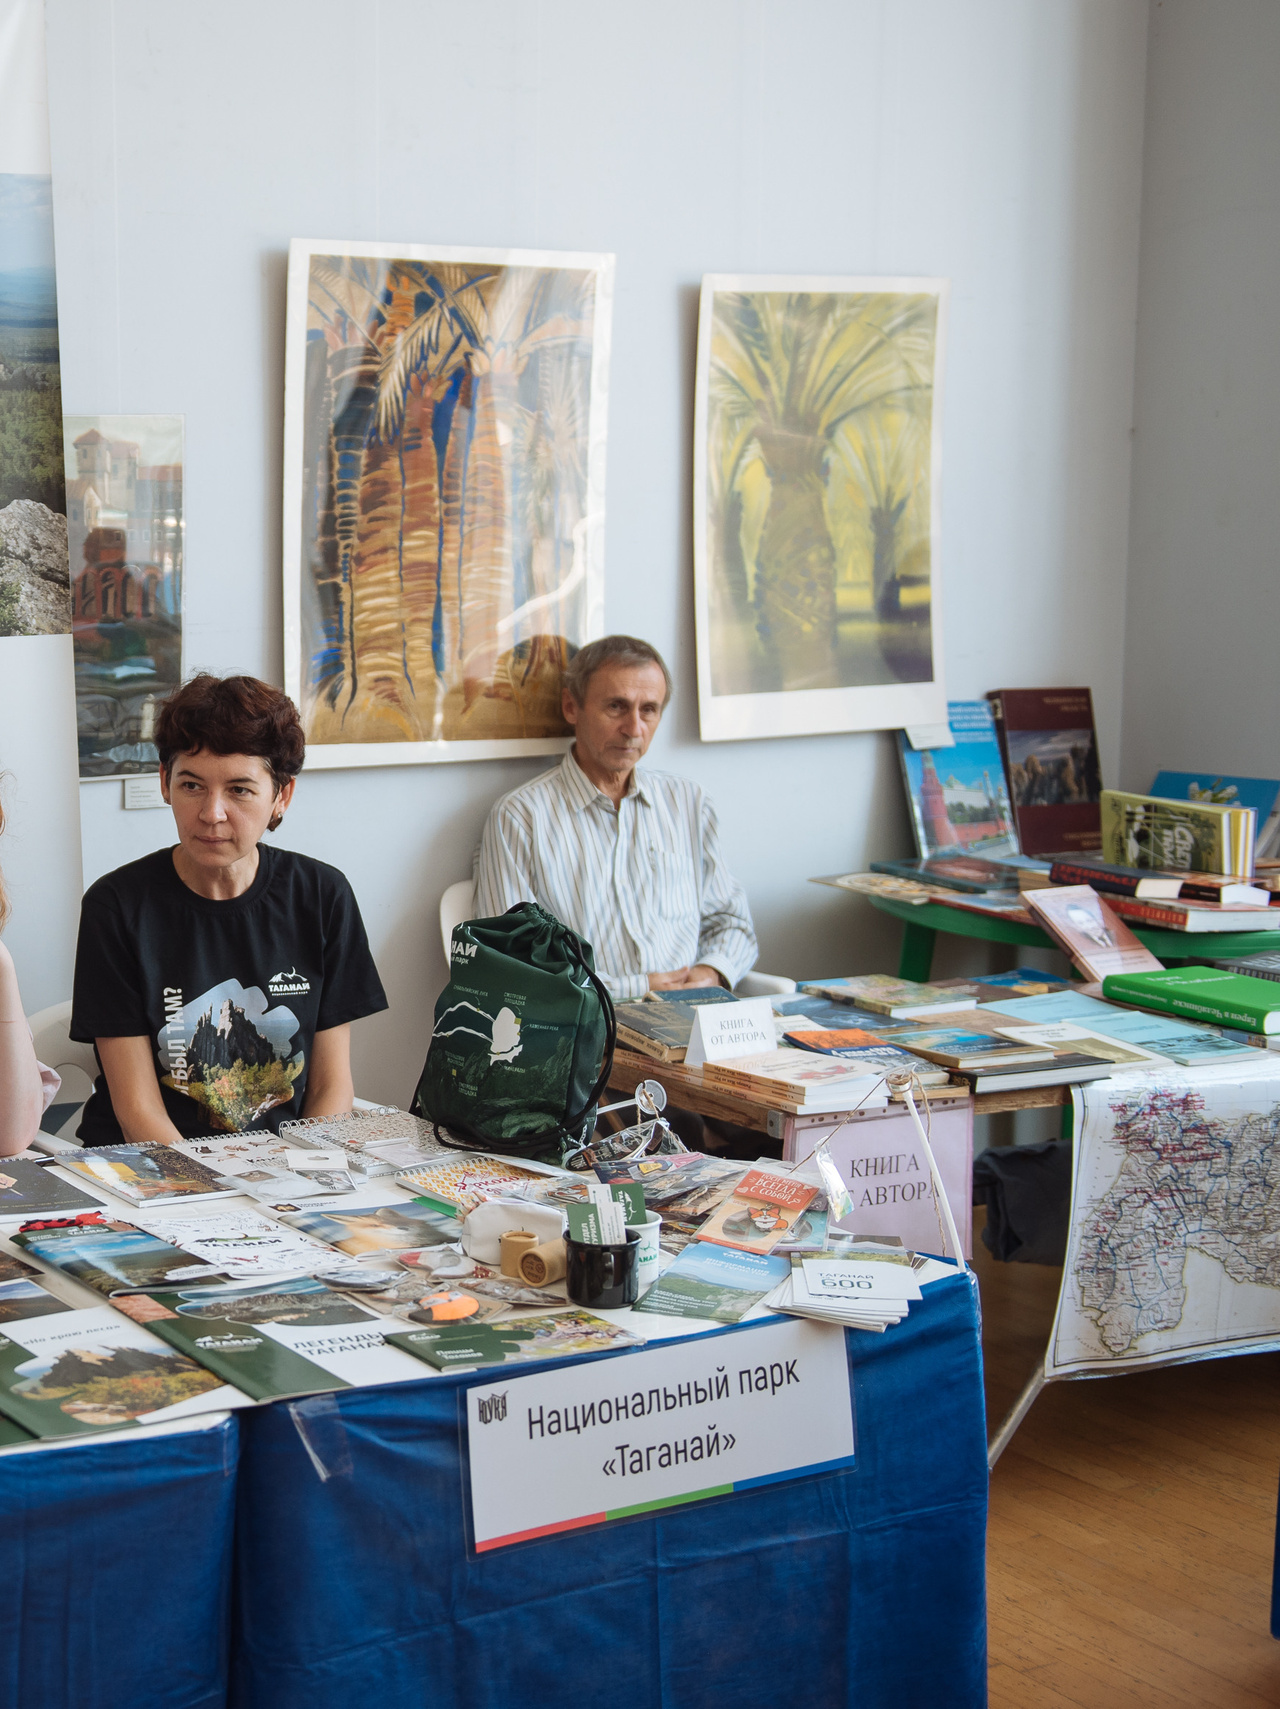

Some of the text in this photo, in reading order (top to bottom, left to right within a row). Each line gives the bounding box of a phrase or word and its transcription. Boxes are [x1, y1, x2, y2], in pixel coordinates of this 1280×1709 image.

[719, 1017, 754, 1031] КНИГА
[163, 986, 189, 1081] БЫЛ ТАМ?
[710, 1031, 767, 1046] ОТ АВТОРА
[849, 1153, 921, 1179] КНИГА
[750, 1185, 757, 1194] С
[754, 1179, 797, 1197] ВСЕГДА
[859, 1181, 941, 1208] АВТОРА
[818, 1272, 874, 1280] ТАГАНАЙ
[821, 1278, 873, 1290] 600
[292, 1332, 385, 1349] ЛЕГЕНДЫ
[527, 1358, 801, 1440] Национальный парк
[602, 1424, 737, 1478] «Таганай»
